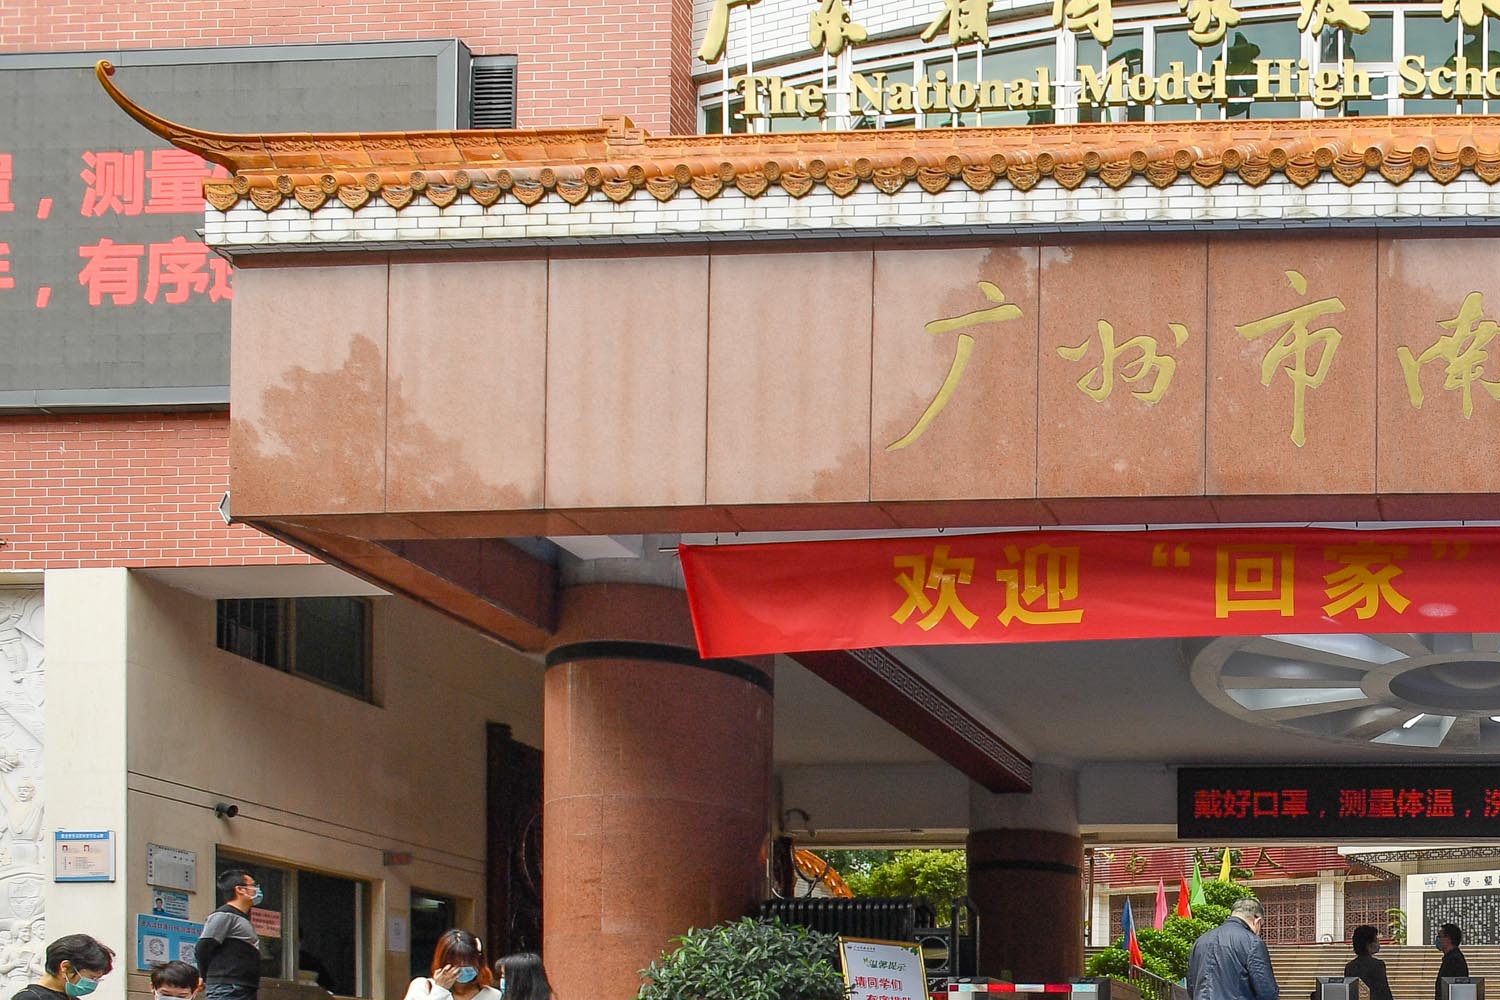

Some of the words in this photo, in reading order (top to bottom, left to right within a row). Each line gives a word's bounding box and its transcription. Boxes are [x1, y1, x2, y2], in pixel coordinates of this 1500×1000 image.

[735, 74, 826, 116] The
[849, 67, 1051, 114] National
[1077, 61, 1227, 105] Model
[1251, 58, 1372, 107] High
[890, 543, 1085, 631] 欢迎
[854, 976, 904, 991] 请同学们
